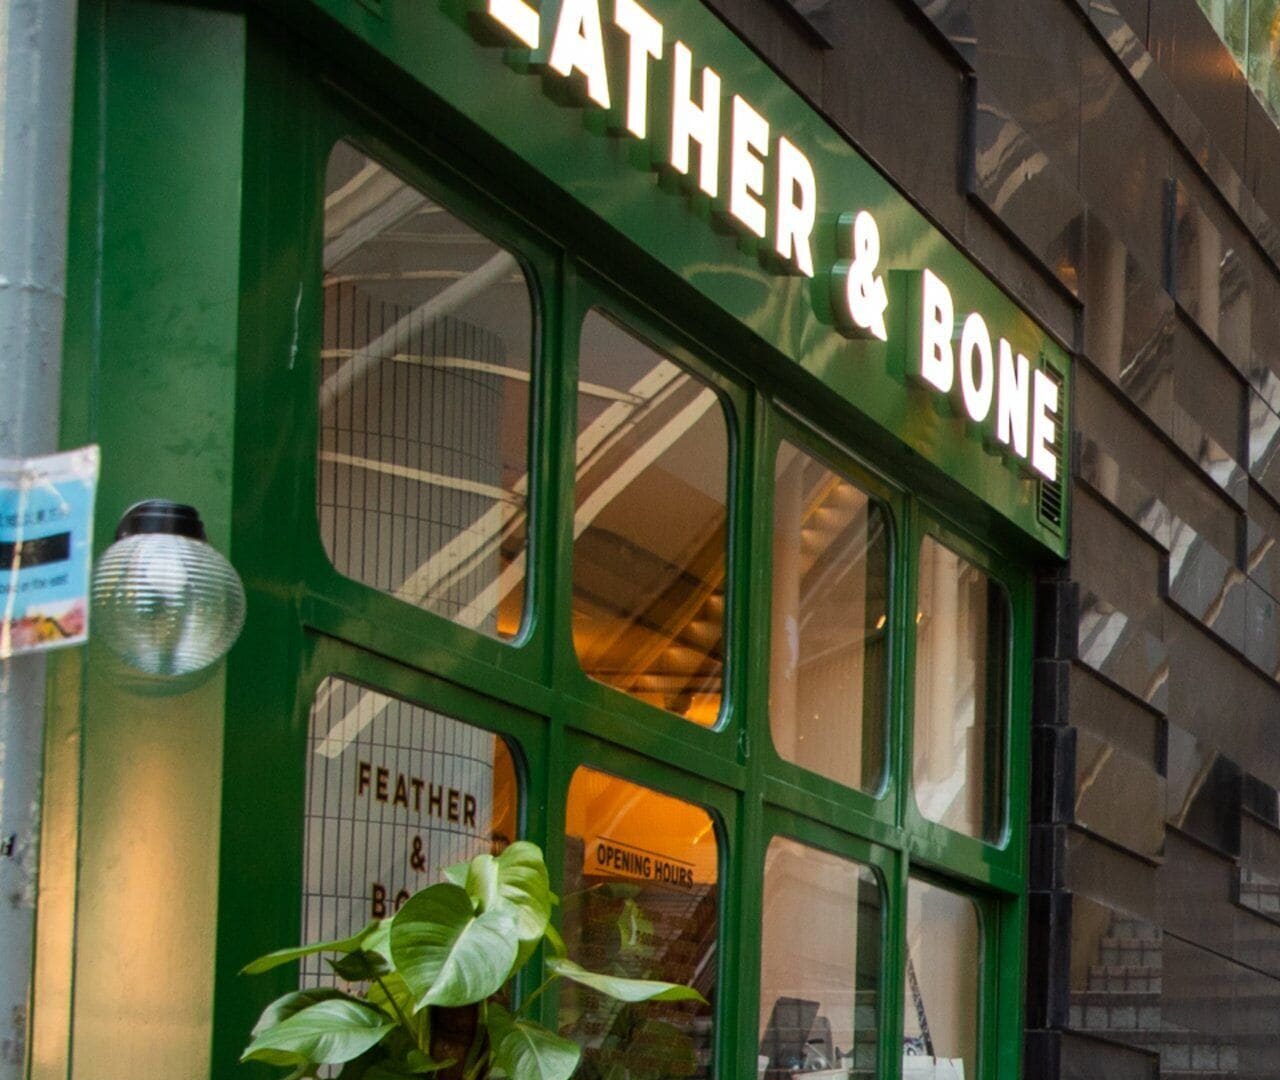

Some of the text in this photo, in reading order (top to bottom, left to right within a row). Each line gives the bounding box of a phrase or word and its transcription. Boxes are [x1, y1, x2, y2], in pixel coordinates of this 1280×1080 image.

[847, 210, 888, 342] &
[921, 268, 1058, 482] BONE
[358, 761, 478, 828] FEATHER
[410, 836, 426, 873] &
[597, 844, 694, 889] OPENING HOURS
